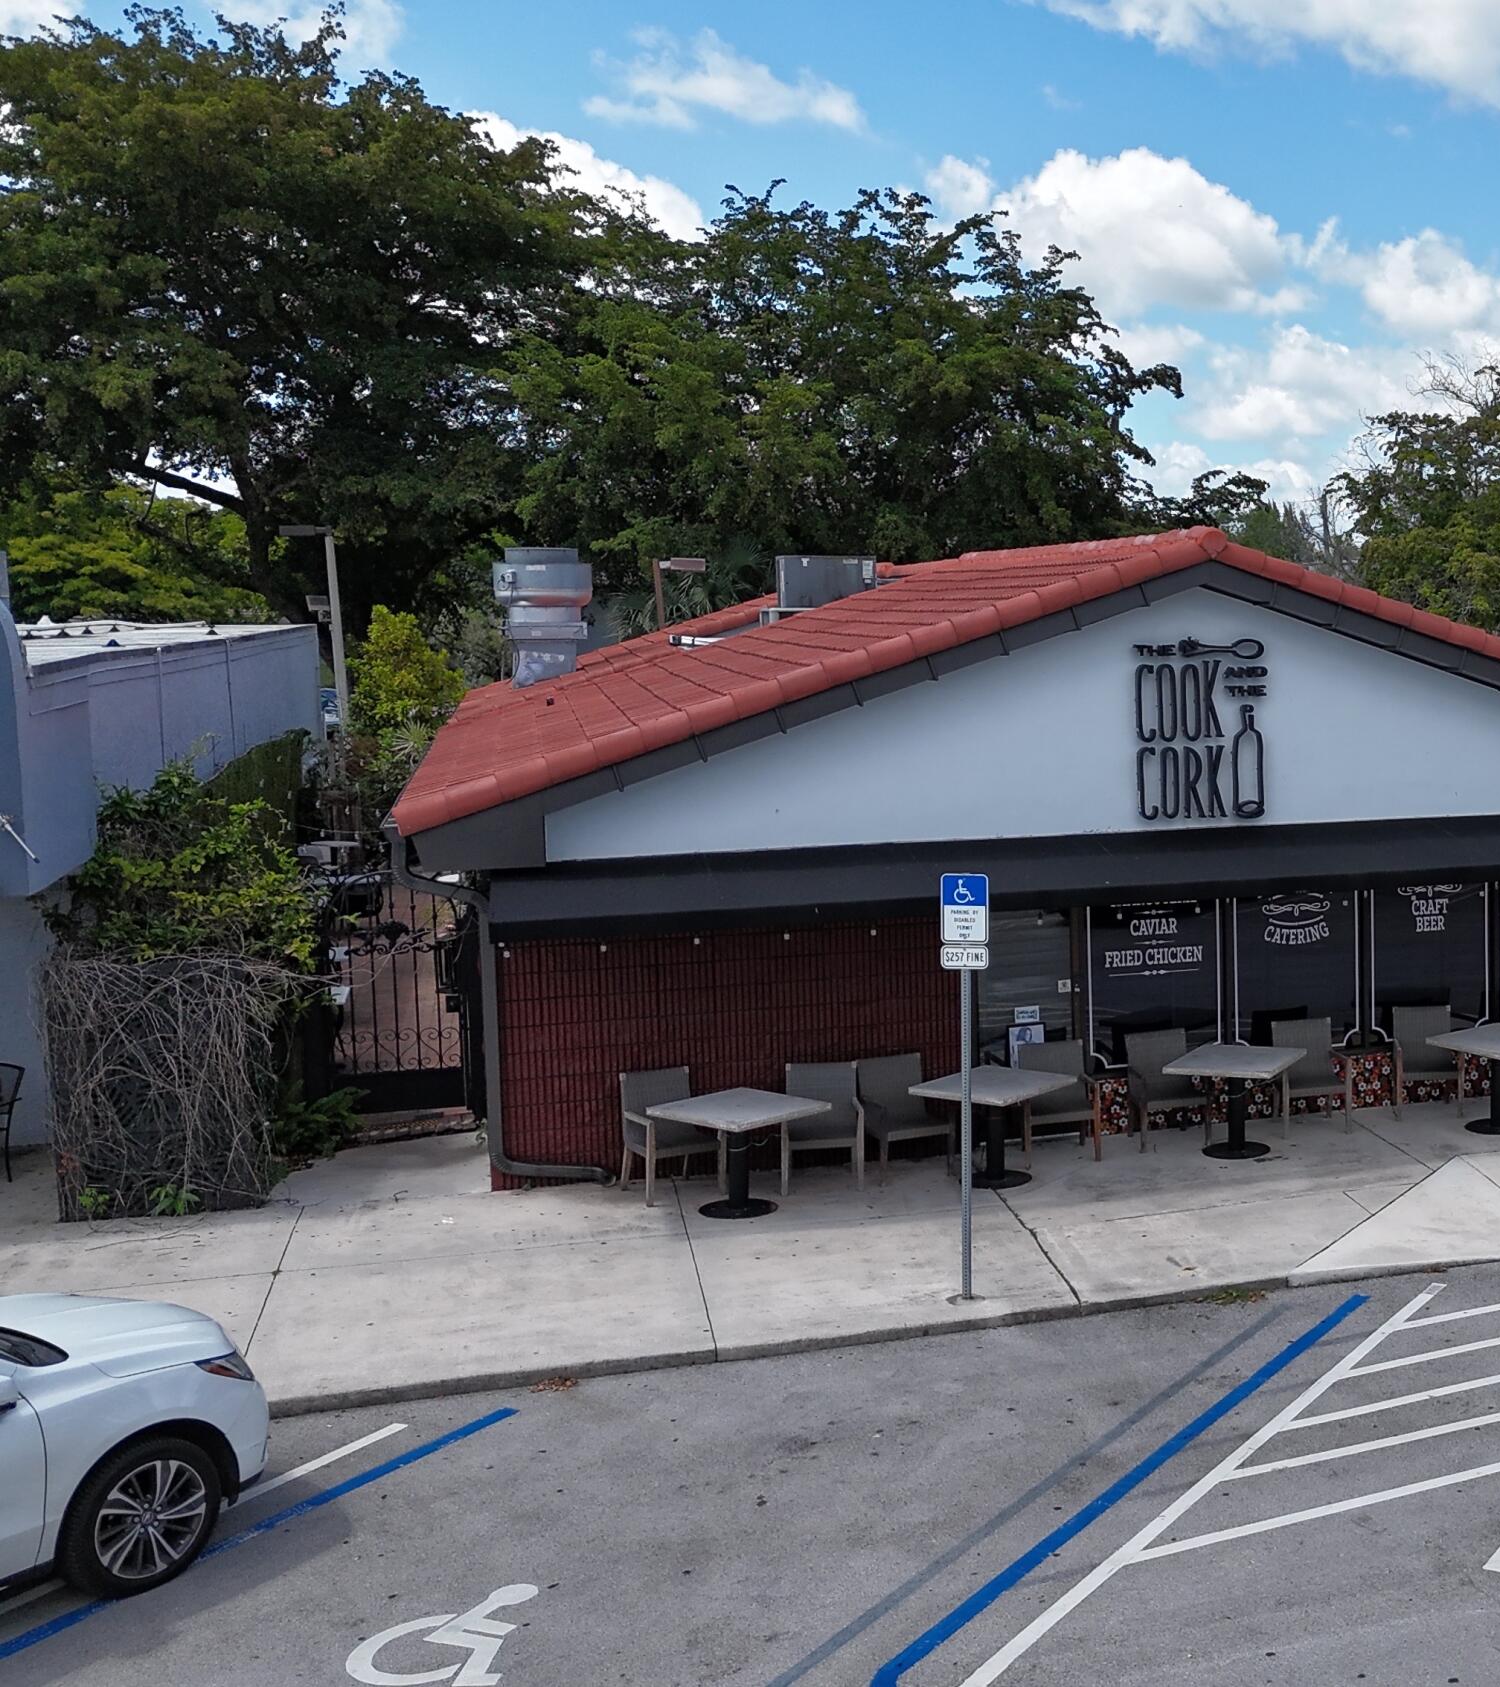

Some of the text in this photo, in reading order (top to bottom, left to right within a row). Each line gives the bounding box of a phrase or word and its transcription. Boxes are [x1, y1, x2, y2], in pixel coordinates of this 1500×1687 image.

[1133, 644, 1176, 657] THE
[1224, 666, 1268, 679] AND
[1224, 685, 1267, 697] THE
[1135, 660, 1225, 742] COOK
[1136, 745, 1228, 820] CORK
[1411, 898, 1449, 916] CRAFT
[1130, 918, 1178, 936] CAVIAR
[1416, 915, 1445, 932] BEER
[1264, 921, 1329, 945] CATERING
[945, 951, 984, 962] $257 FINE
[1104, 945, 1204, 968] FRIED CHICKEN
